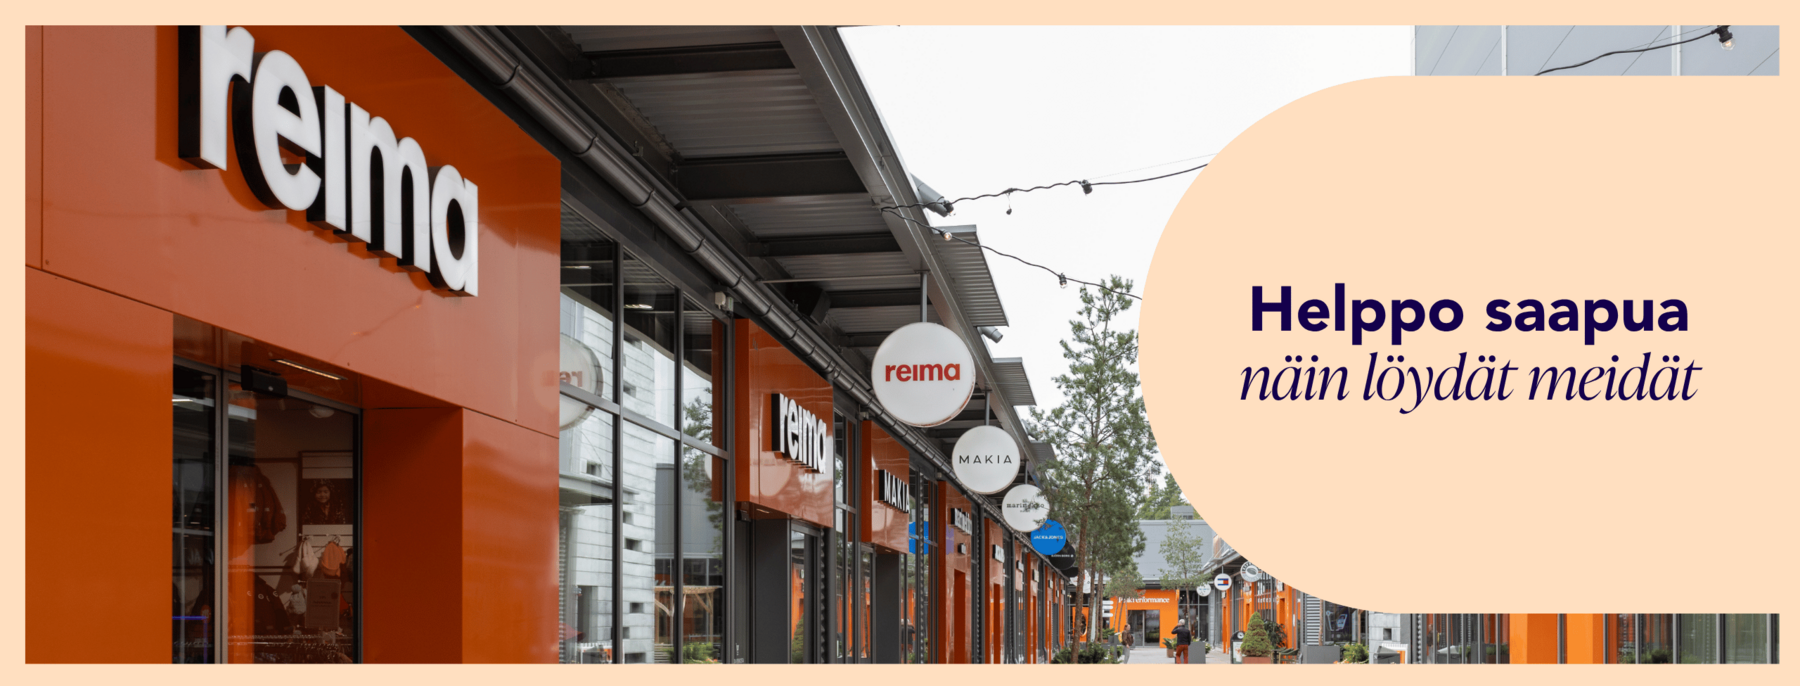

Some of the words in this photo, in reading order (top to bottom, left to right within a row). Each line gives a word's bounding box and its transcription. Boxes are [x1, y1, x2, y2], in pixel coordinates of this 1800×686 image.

[198, 25, 479, 297] reima
[884, 362, 961, 383] reima
[779, 393, 827, 474] reima
[958, 454, 1013, 465] MAKIA
[884, 469, 911, 514] MAKIA
